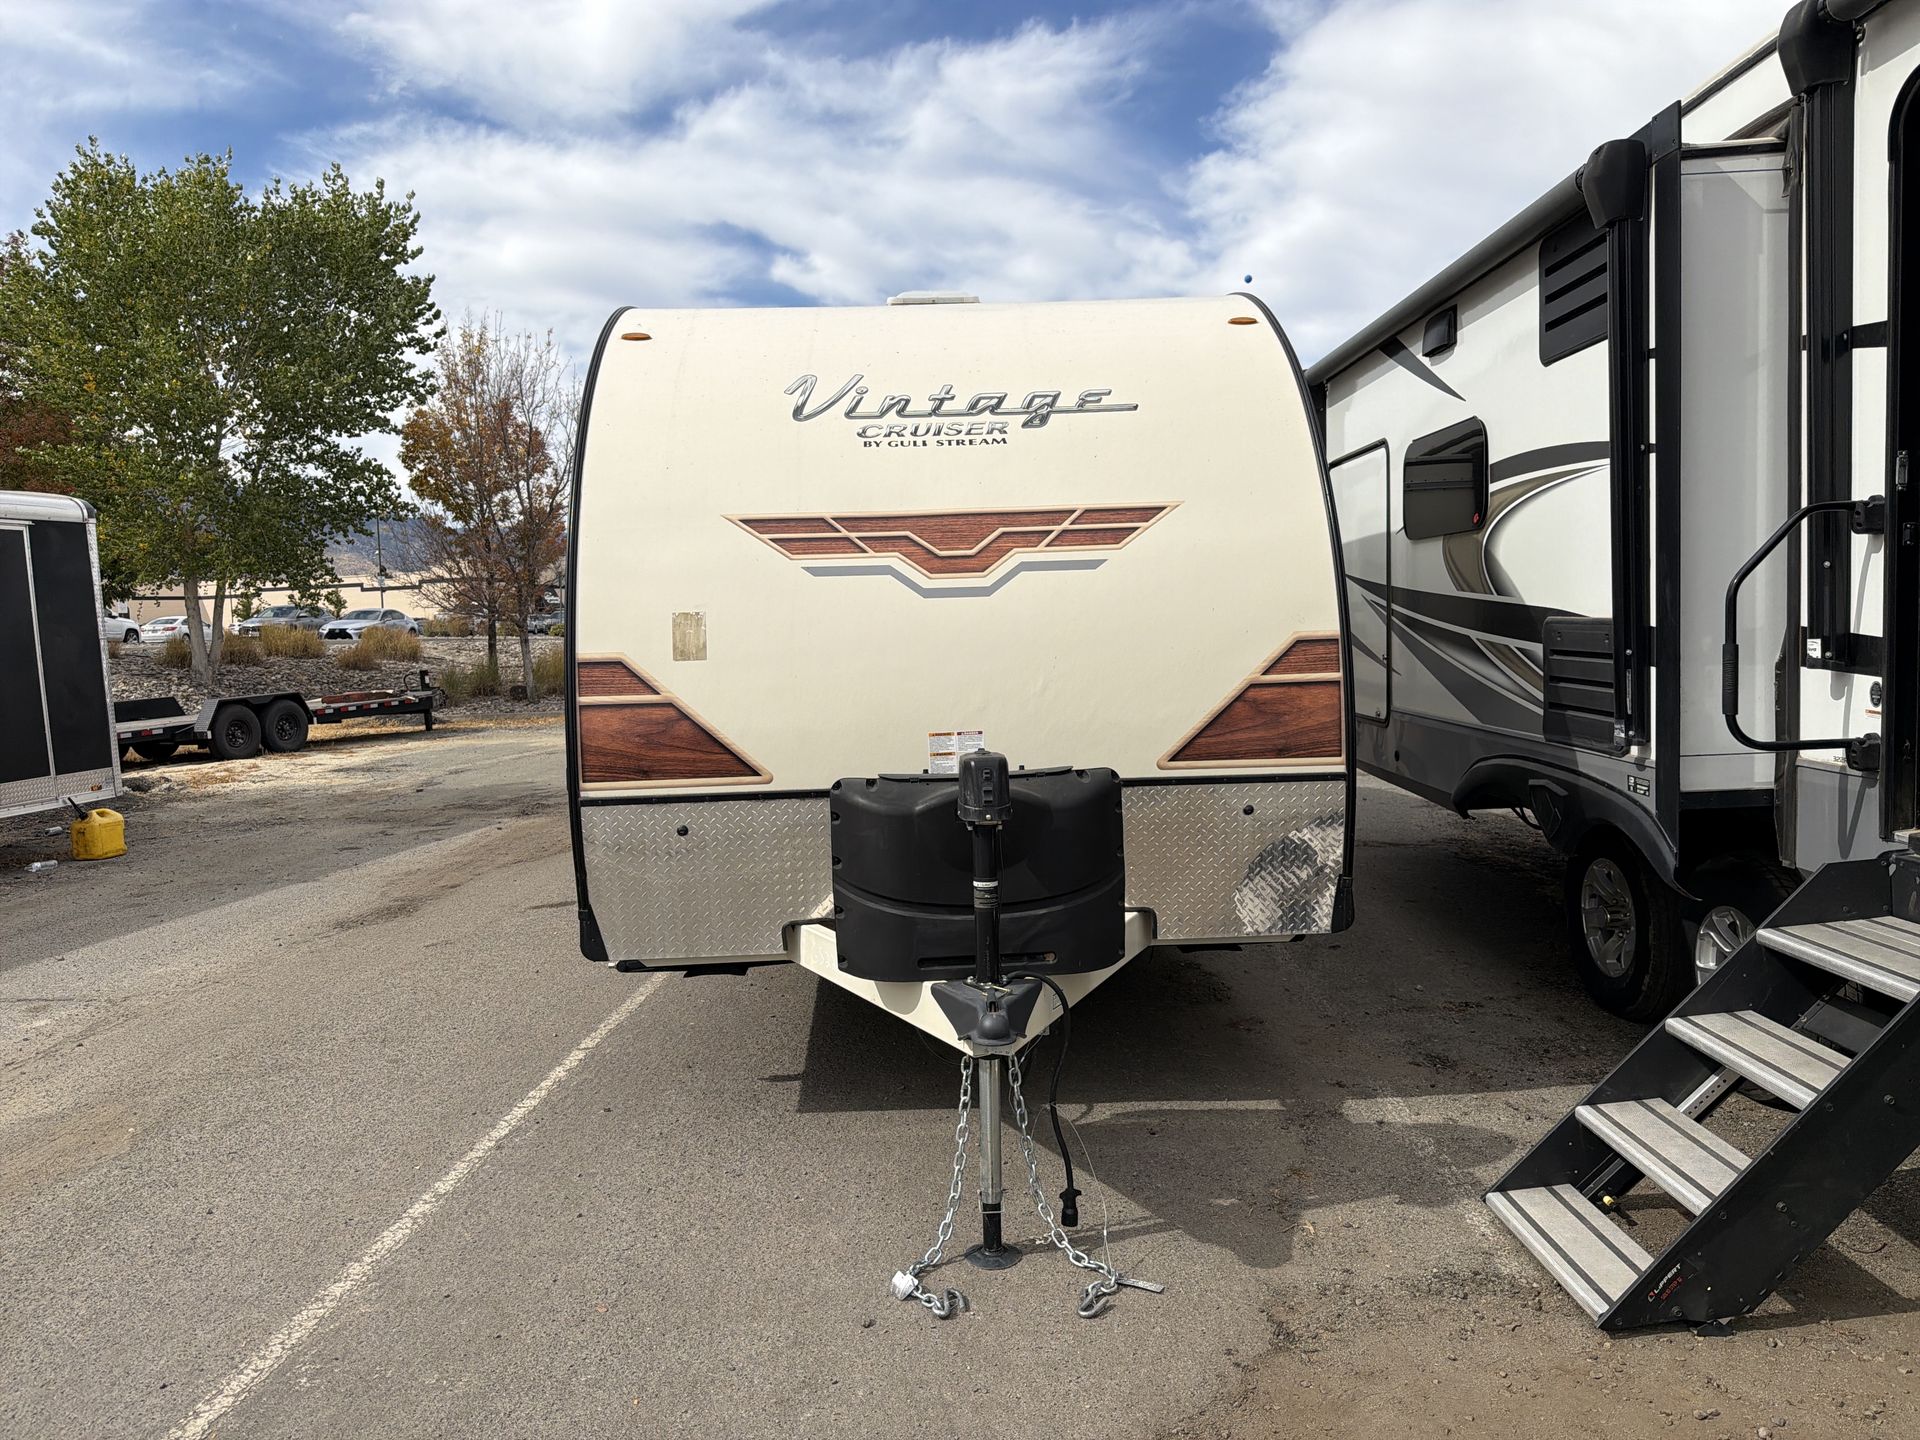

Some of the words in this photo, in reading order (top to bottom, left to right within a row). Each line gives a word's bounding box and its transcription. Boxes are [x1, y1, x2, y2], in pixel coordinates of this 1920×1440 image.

[784, 374, 1138, 429] Vintage
[856, 421, 1010, 439] CRUISER
[863, 440, 882, 448] BY
[936, 437, 1008, 447] STREAM
[1653, 1263, 1681, 1294] LIPPERT
